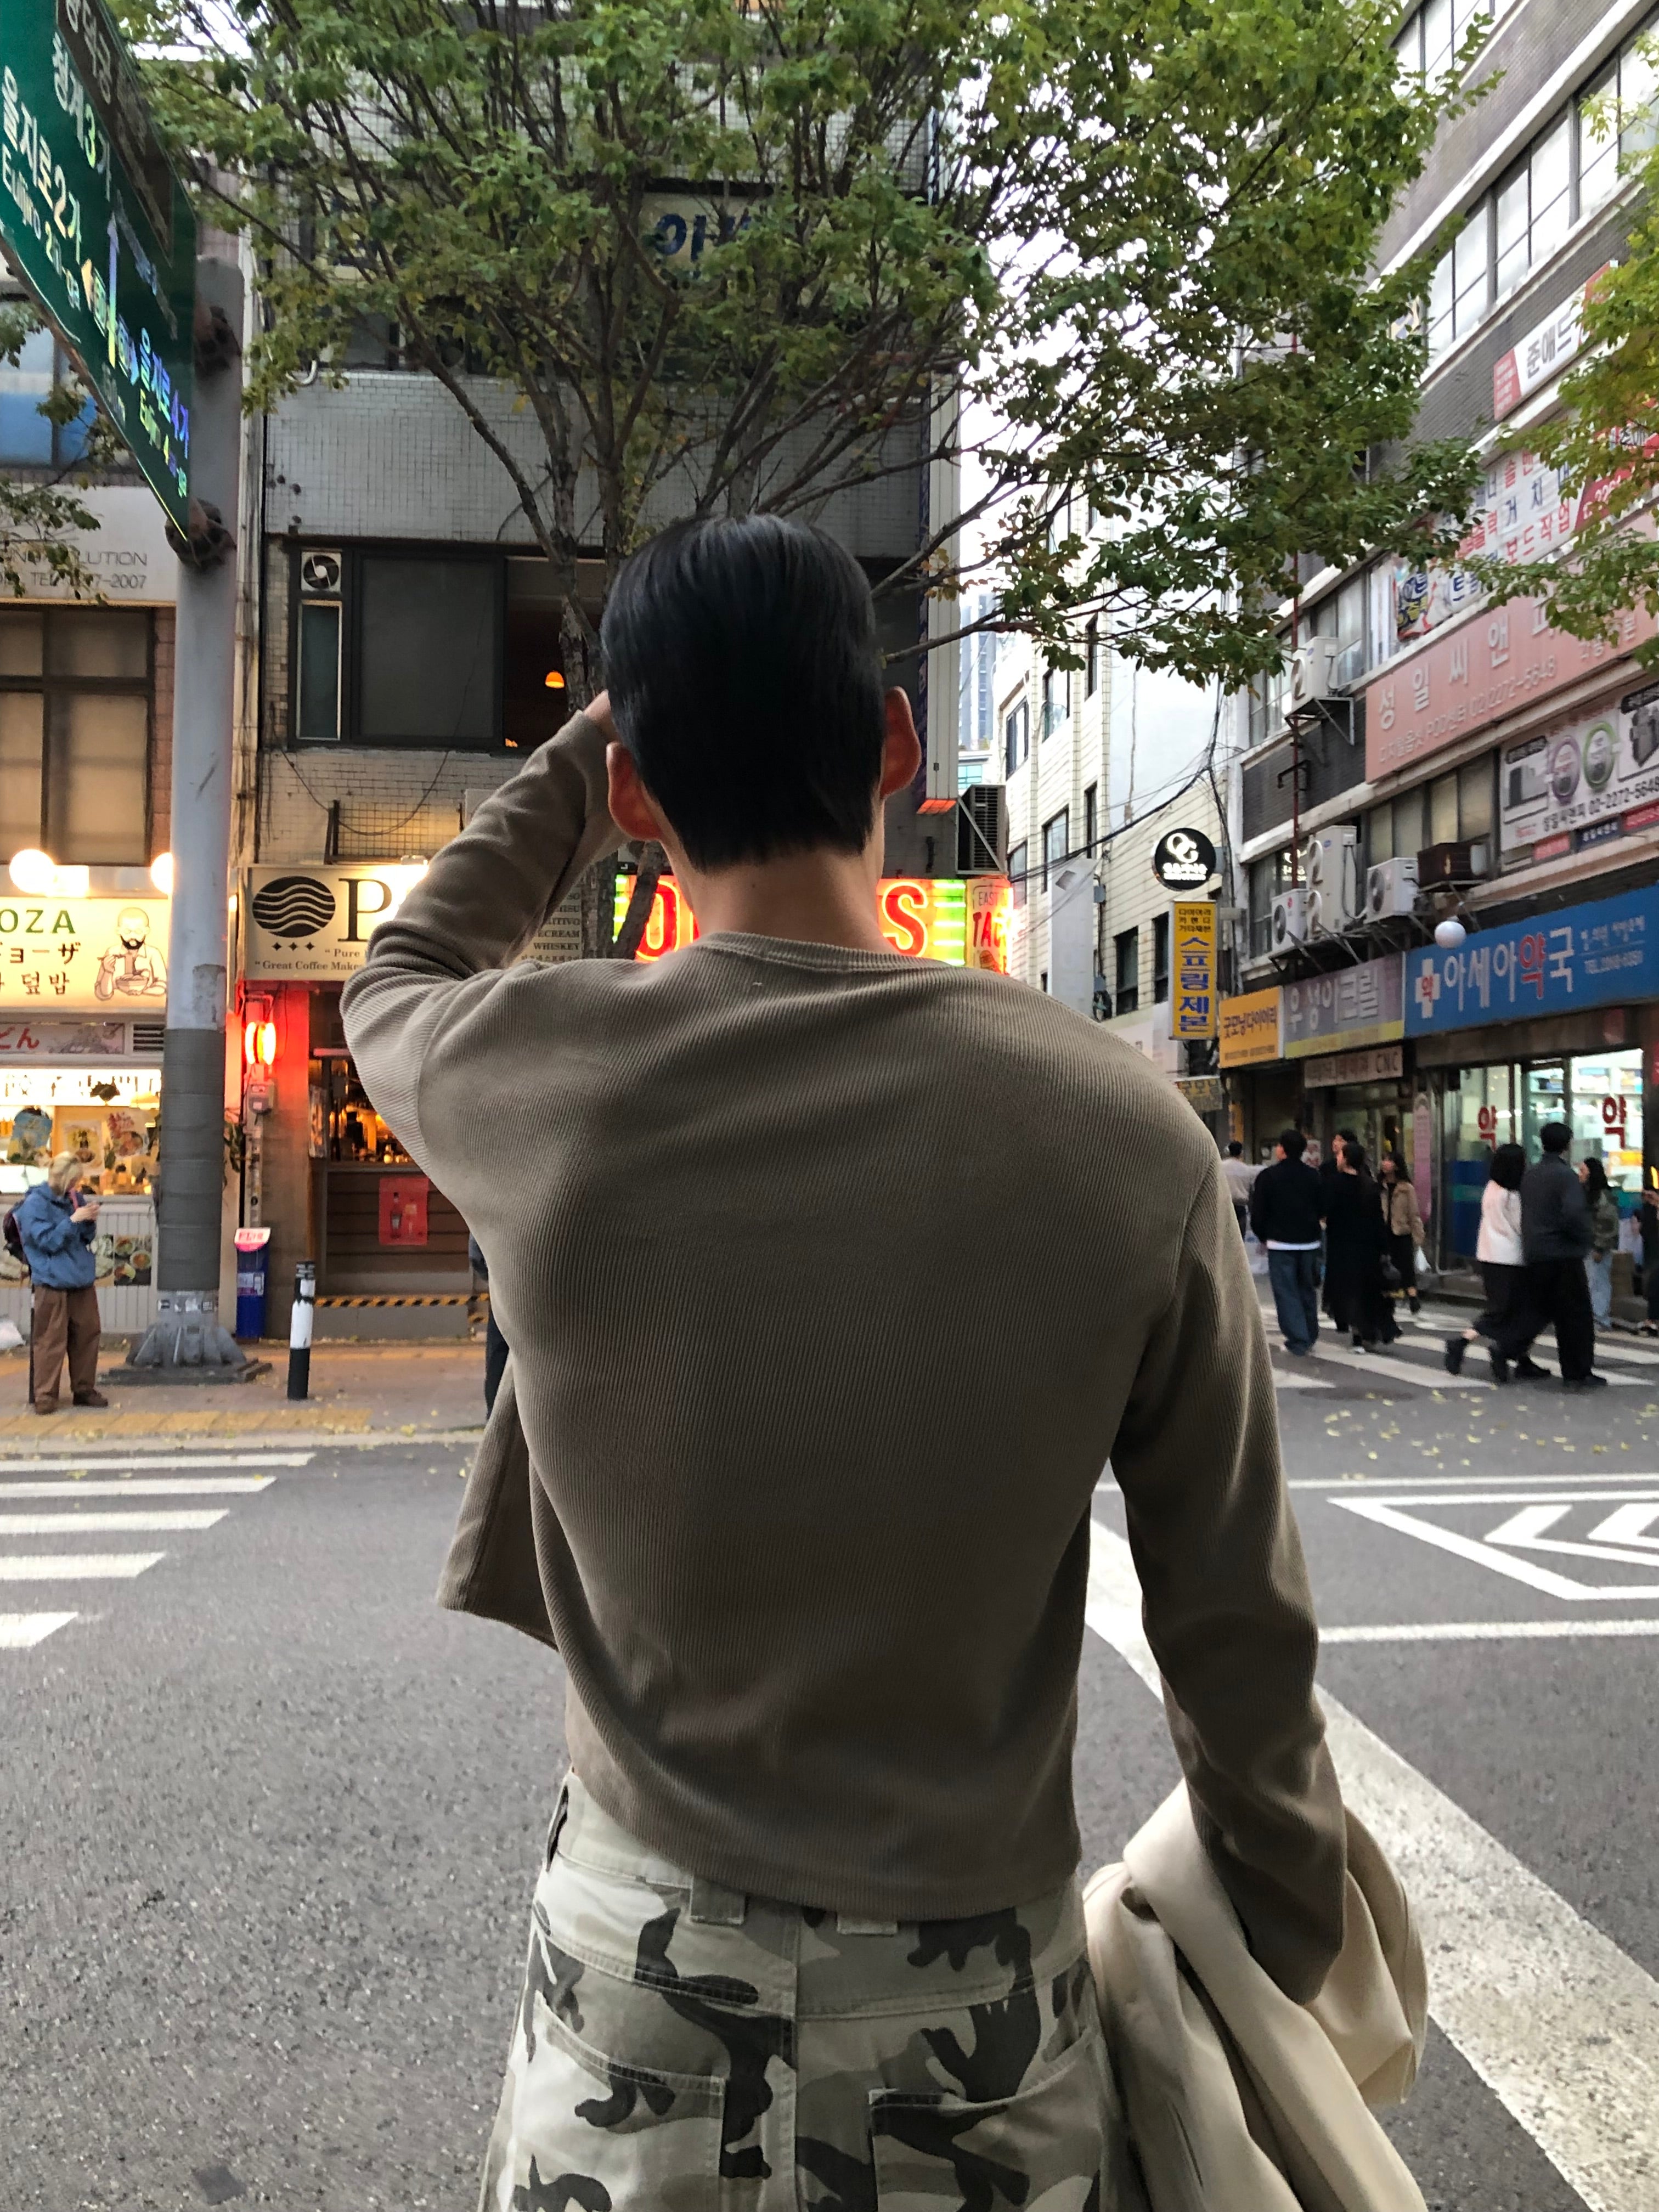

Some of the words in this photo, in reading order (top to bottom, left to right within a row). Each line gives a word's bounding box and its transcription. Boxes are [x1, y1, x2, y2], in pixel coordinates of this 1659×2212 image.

[2, 66, 82, 264] 을지로2가
[1527, 311, 1572, 379] 준애드
[139, 328, 189, 460] 을지로4가
[0, 941, 81, 965] ョーザ
[295, 961, 328, 970] Coffee
[533, 943, 580, 951] WHISKEY
[1443, 926, 1575, 1012] 아세아약국
[1179, 936, 1211, 1032] 스프링제본
[1477, 1104, 1498, 1152] 약
[1602, 1094, 1627, 1149] 약
